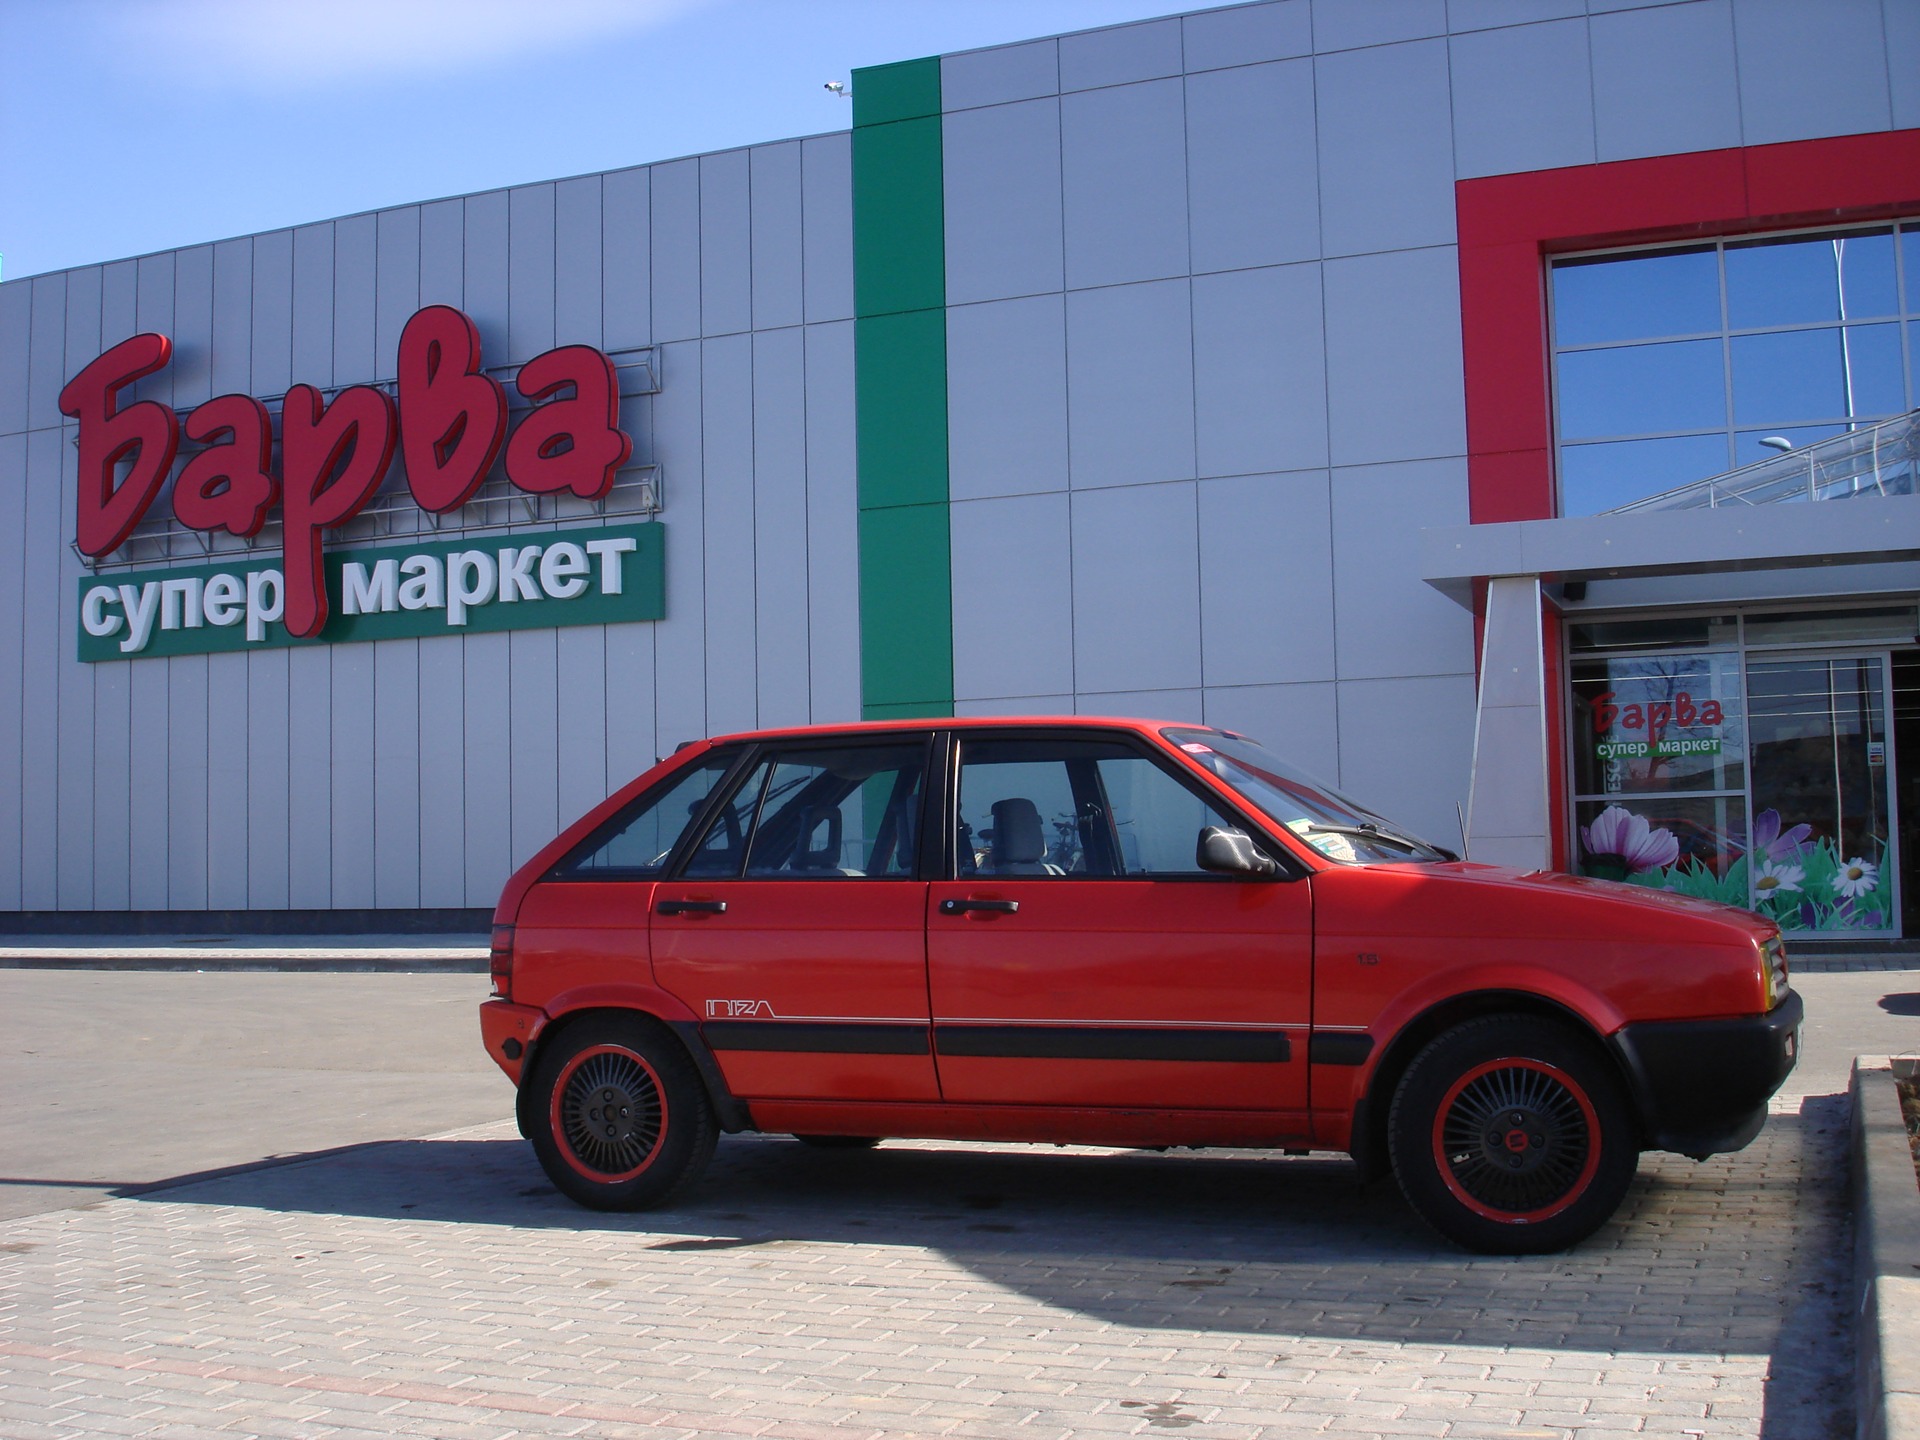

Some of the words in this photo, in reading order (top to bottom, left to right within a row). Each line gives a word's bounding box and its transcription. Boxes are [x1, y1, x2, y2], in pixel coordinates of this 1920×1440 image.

[59, 304, 632, 639] Барва
[81, 568, 284, 653] супер
[342, 537, 638, 627] маркет
[1589, 691, 1725, 748] Барва
[1597, 742, 1648, 758] супер
[1658, 739, 1719, 755] маркет
